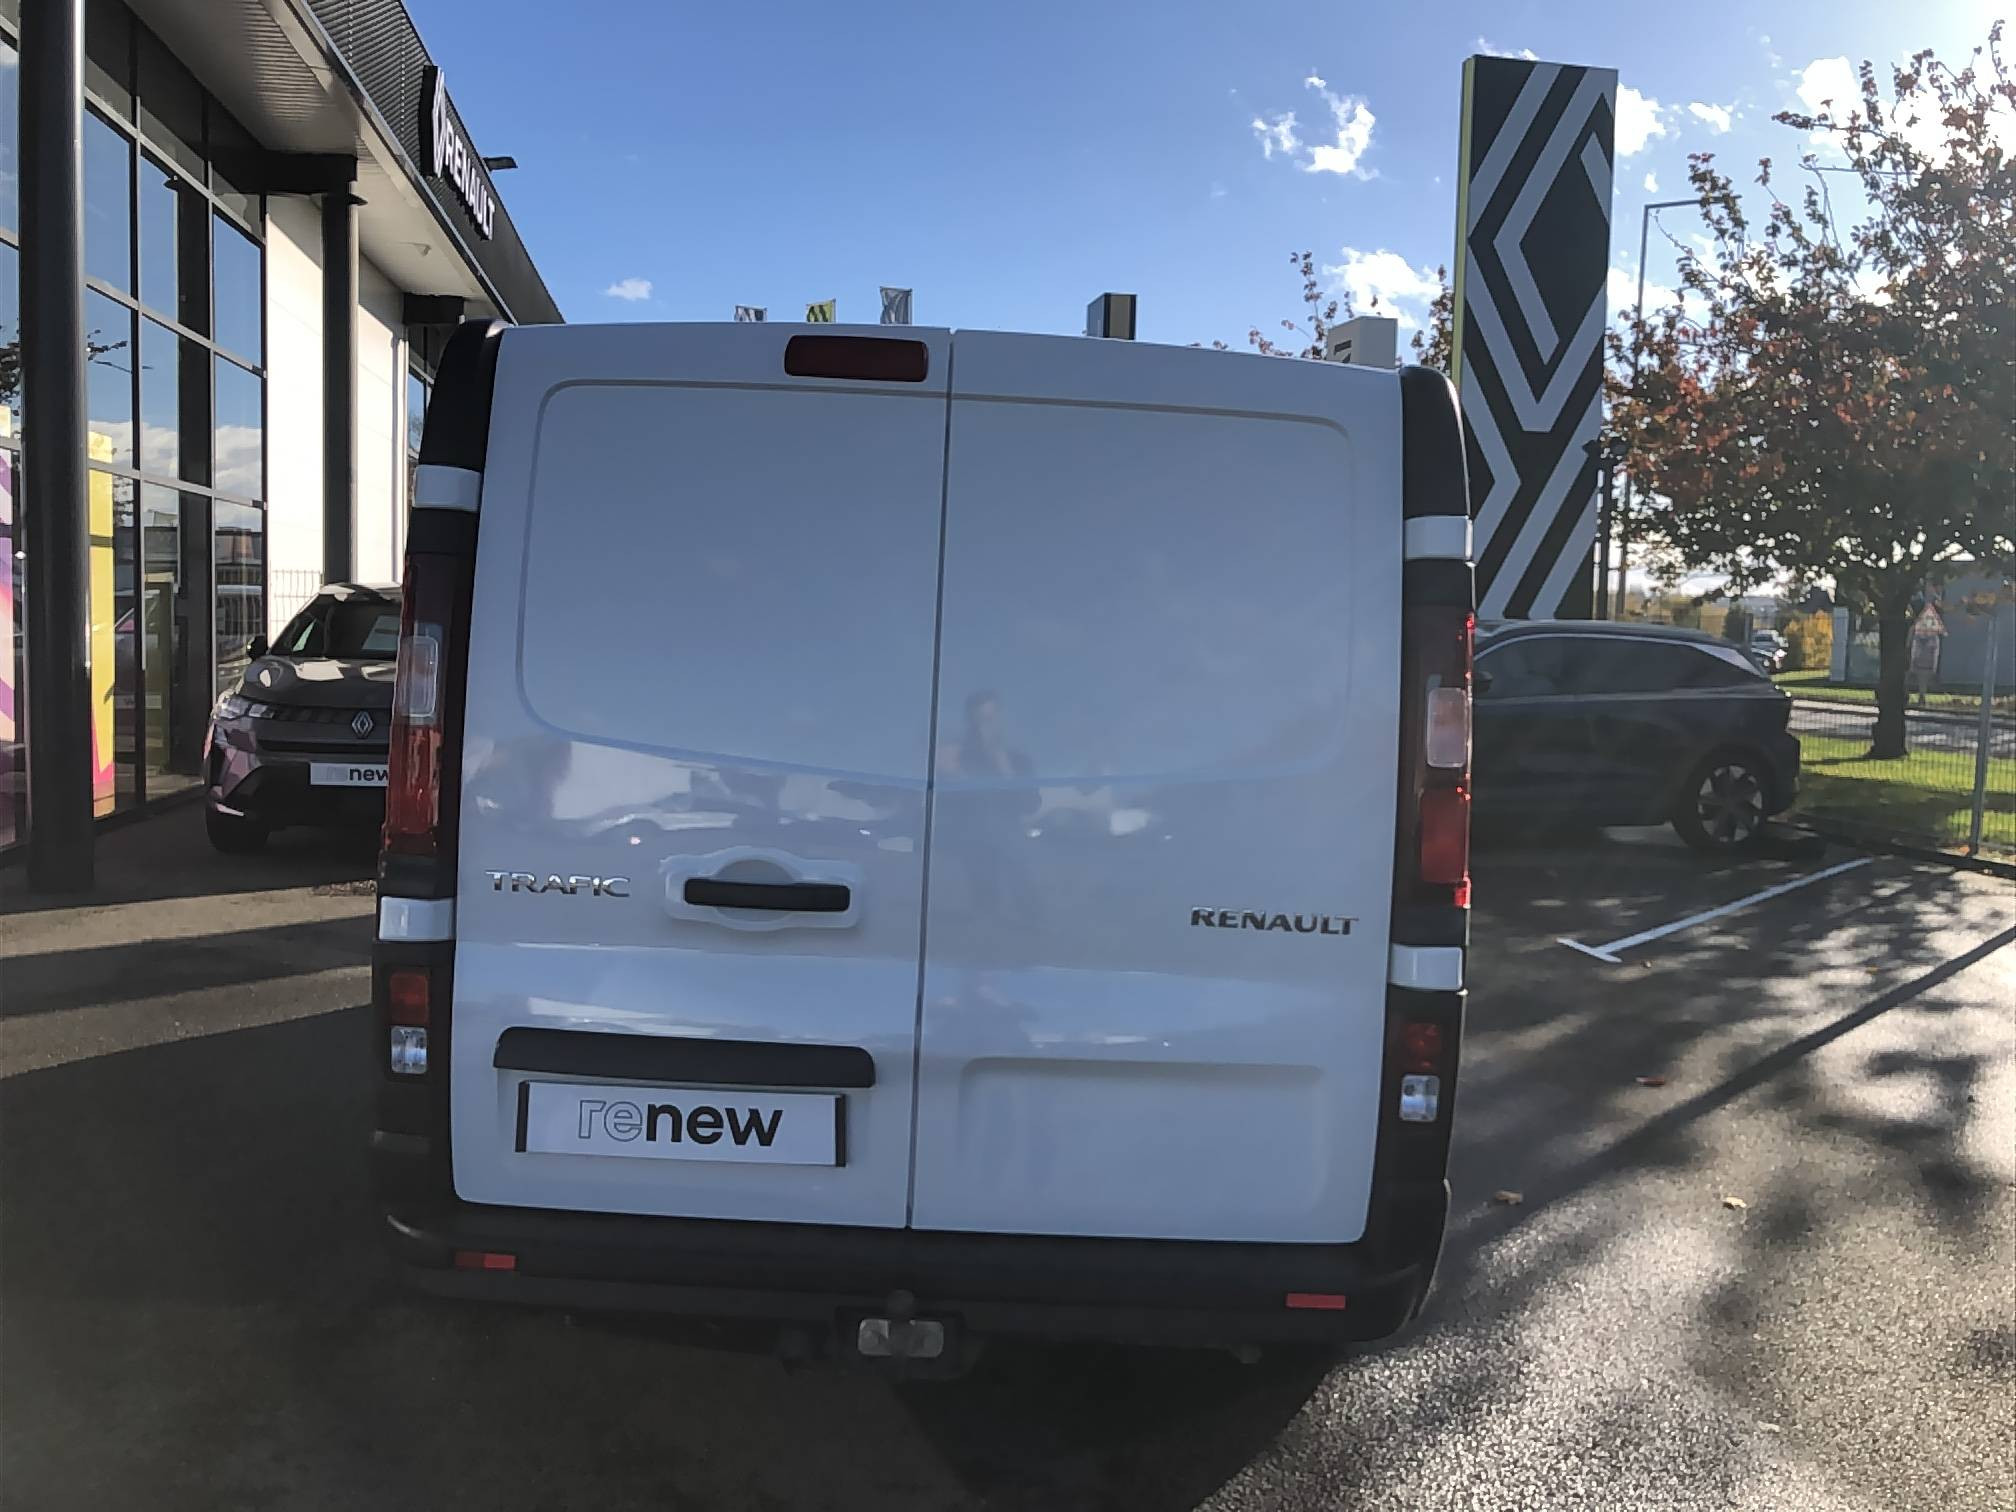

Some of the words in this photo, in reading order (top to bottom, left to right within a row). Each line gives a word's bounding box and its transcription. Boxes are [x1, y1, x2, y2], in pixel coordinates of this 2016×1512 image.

[445, 118, 496, 241] RENAULT
[485, 871, 631, 898] TRAFIC
[1190, 906, 1360, 936] RENAULT
[578, 1099, 783, 1147] renew
